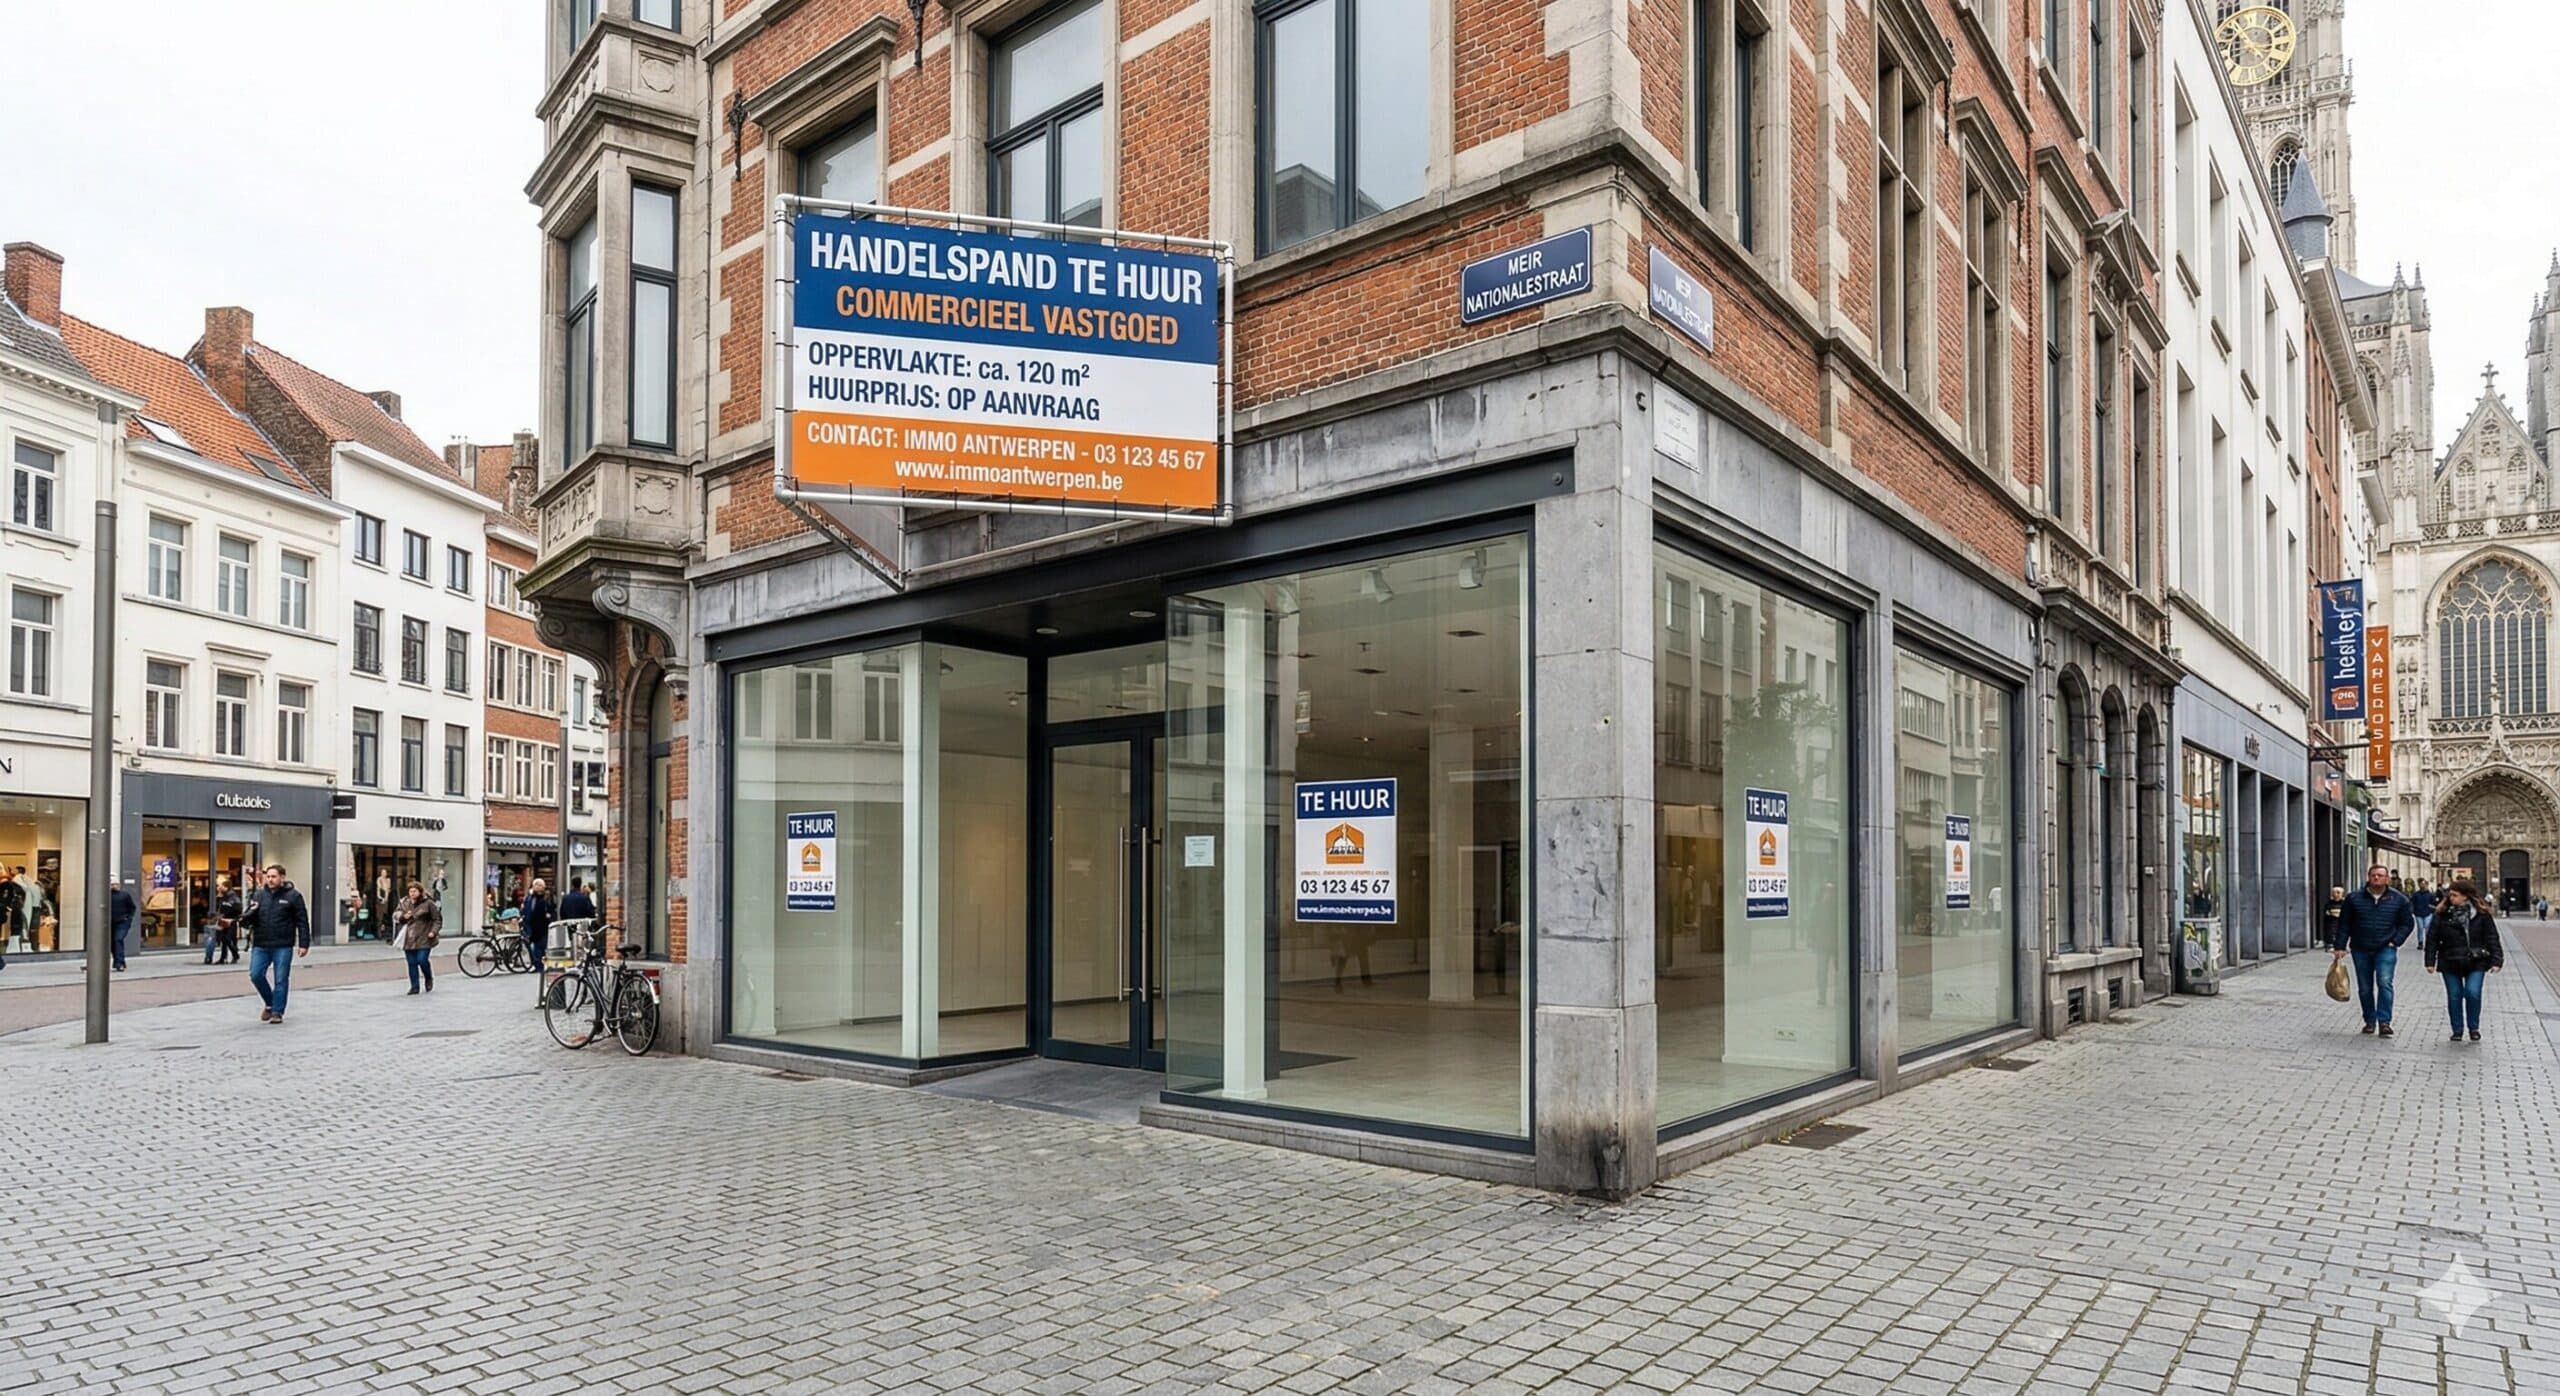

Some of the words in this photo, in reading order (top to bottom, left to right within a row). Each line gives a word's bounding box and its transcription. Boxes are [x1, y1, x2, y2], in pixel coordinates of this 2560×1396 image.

[811, 231, 1057, 290] HANDELSPAND
[1067, 257, 1107, 295] TE
[1117, 262, 1203, 305] HUUR
[1508, 251, 1543, 276] MEIR
[1466, 262, 1584, 314] NATIONALESTRAAT
[836, 285, 1034, 333] COMMERCIEEL
[1043, 305, 1178, 345] VASTGOED
[809, 341, 972, 378] OPPERVLAKTE:
[978, 361, 1010, 382] ca.
[1017, 360, 1055, 384] 120
[1062, 363, 1090, 387] m²
[809, 376, 940, 410] HUURPRIJS:
[947, 387, 976, 413] OP
[983, 390, 1100, 421] AANVRAAG
[807, 421, 898, 448] CONTACT:
[904, 429, 958, 453] IMMO
[963, 434, 1075, 461] ANTWERPEN
[1094, 443, 1115, 465] 03
[1122, 445, 1153, 467] 123
[1158, 449, 1181, 469] 45
[1184, 451, 1205, 470] 67
[894, 459, 1123, 491] www.immoantwerpen.be
[1300, 791, 1325, 812] TE
[1331, 788, 1390, 811] HUUR
[1748, 796, 1760, 816] TE
[789, 820, 802, 834] TE
[804, 818, 834, 834] HUUR
[1300, 880, 1318, 894] 03
[1322, 880, 1347, 894] 123
[1350, 880, 1368, 894] 45
[1372, 880, 1390, 894] 67
